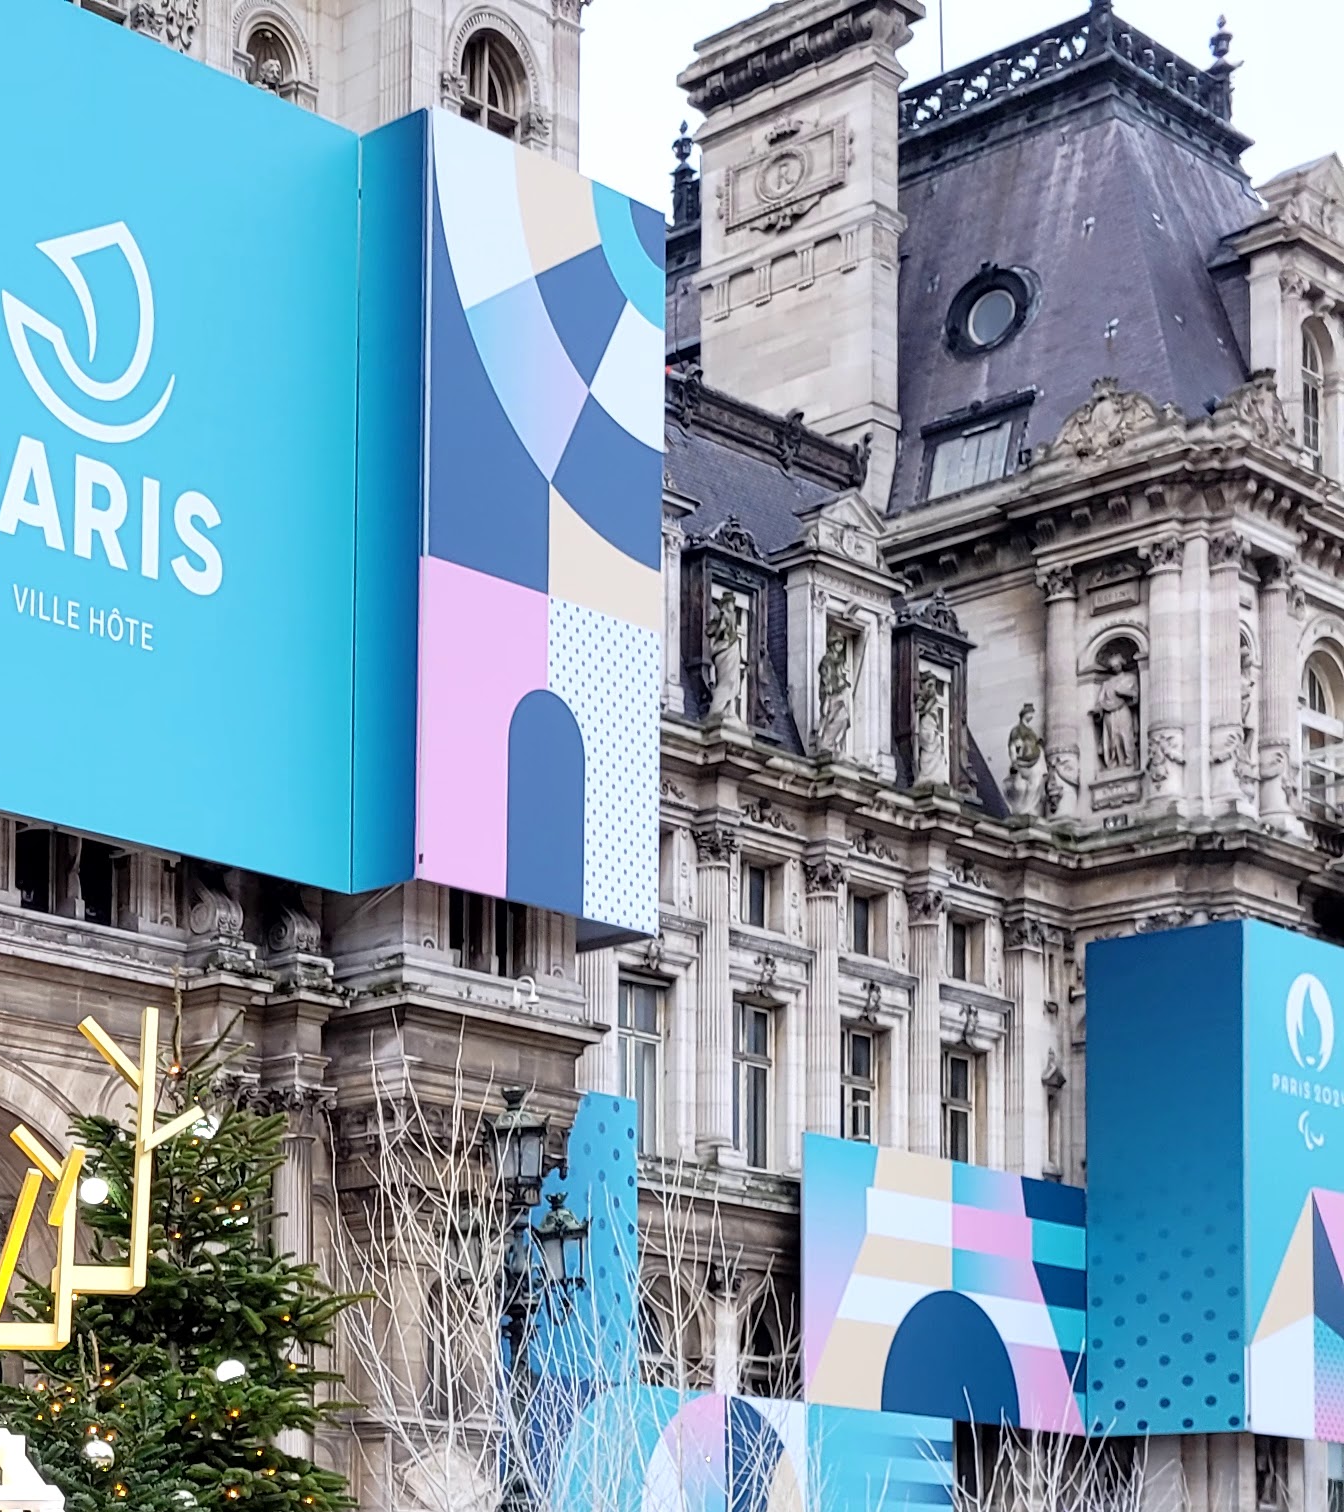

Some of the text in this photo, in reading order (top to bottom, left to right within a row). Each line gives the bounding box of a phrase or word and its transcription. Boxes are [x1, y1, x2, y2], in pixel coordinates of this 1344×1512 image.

[13, 583, 154, 651] VILLE HÔTE
[1271, 1072, 1311, 1100] PARIS
